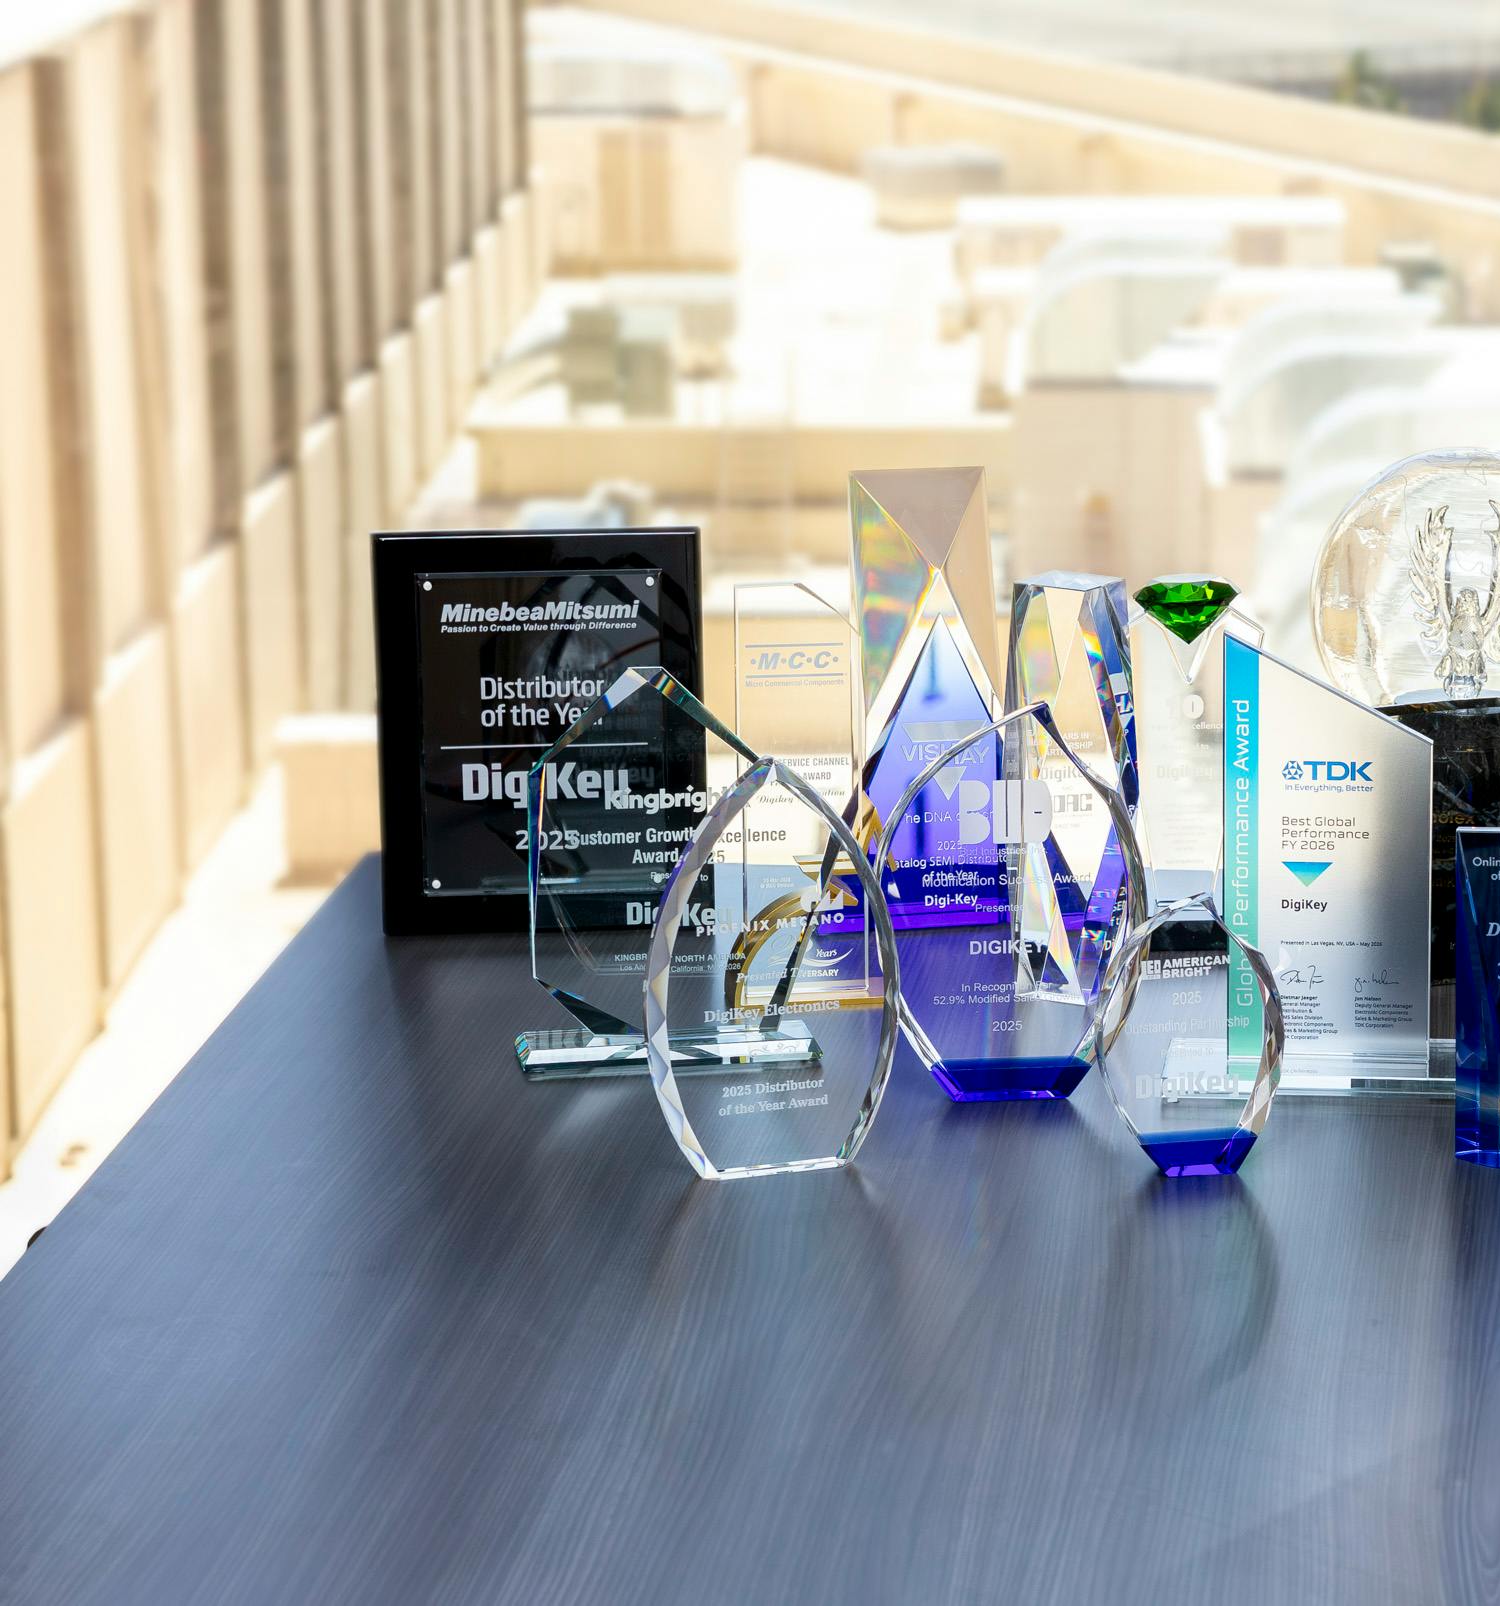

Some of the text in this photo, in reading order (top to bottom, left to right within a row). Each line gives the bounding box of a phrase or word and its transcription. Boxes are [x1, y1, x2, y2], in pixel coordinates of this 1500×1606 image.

[440, 600, 640, 623] MinebeaMitsumi
[441, 625, 477, 634] Passion
[490, 624, 521, 632] Create
[523, 623, 548, 631] Value
[550, 623, 587, 632] through
[589, 621, 637, 630] Difference
[480, 676, 604, 700] Distributor
[481, 703, 549, 728] of the
[1303, 761, 1374, 782] TDK
[1295, 784, 1345, 793] Everything,
[924, 812, 952, 824] DNA
[1232, 699, 1250, 926] Performance Award
[1281, 816, 1356, 827] Best Global
[1281, 829, 1370, 840] Performance
[1281, 841, 1335, 850] FY 2026
[930, 856, 955, 867] SEMI
[924, 893, 979, 909] Digi-Key
[1281, 900, 1328, 912] DigiKey
[696, 919, 769, 937] PHOENIX
[969, 939, 1043, 956] DIGIKEY
[675, 955, 705, 963] NORTH
[1163, 954, 1231, 969] AMERICAN
[1162, 966, 1212, 979] BRIGHT
[962, 984, 970, 993] In
[933, 994, 1010, 1006] 52.9% Modified
[1172, 991, 1202, 1005] 2025
[704, 999, 840, 1024] DigiKey Electronics
[992, 1020, 1023, 1032] 2025
[722, 1078, 824, 1098] 2025 Distributor
[1136, 1070, 1239, 1103] DigiKey
[719, 1095, 829, 1117] of the Year Award
